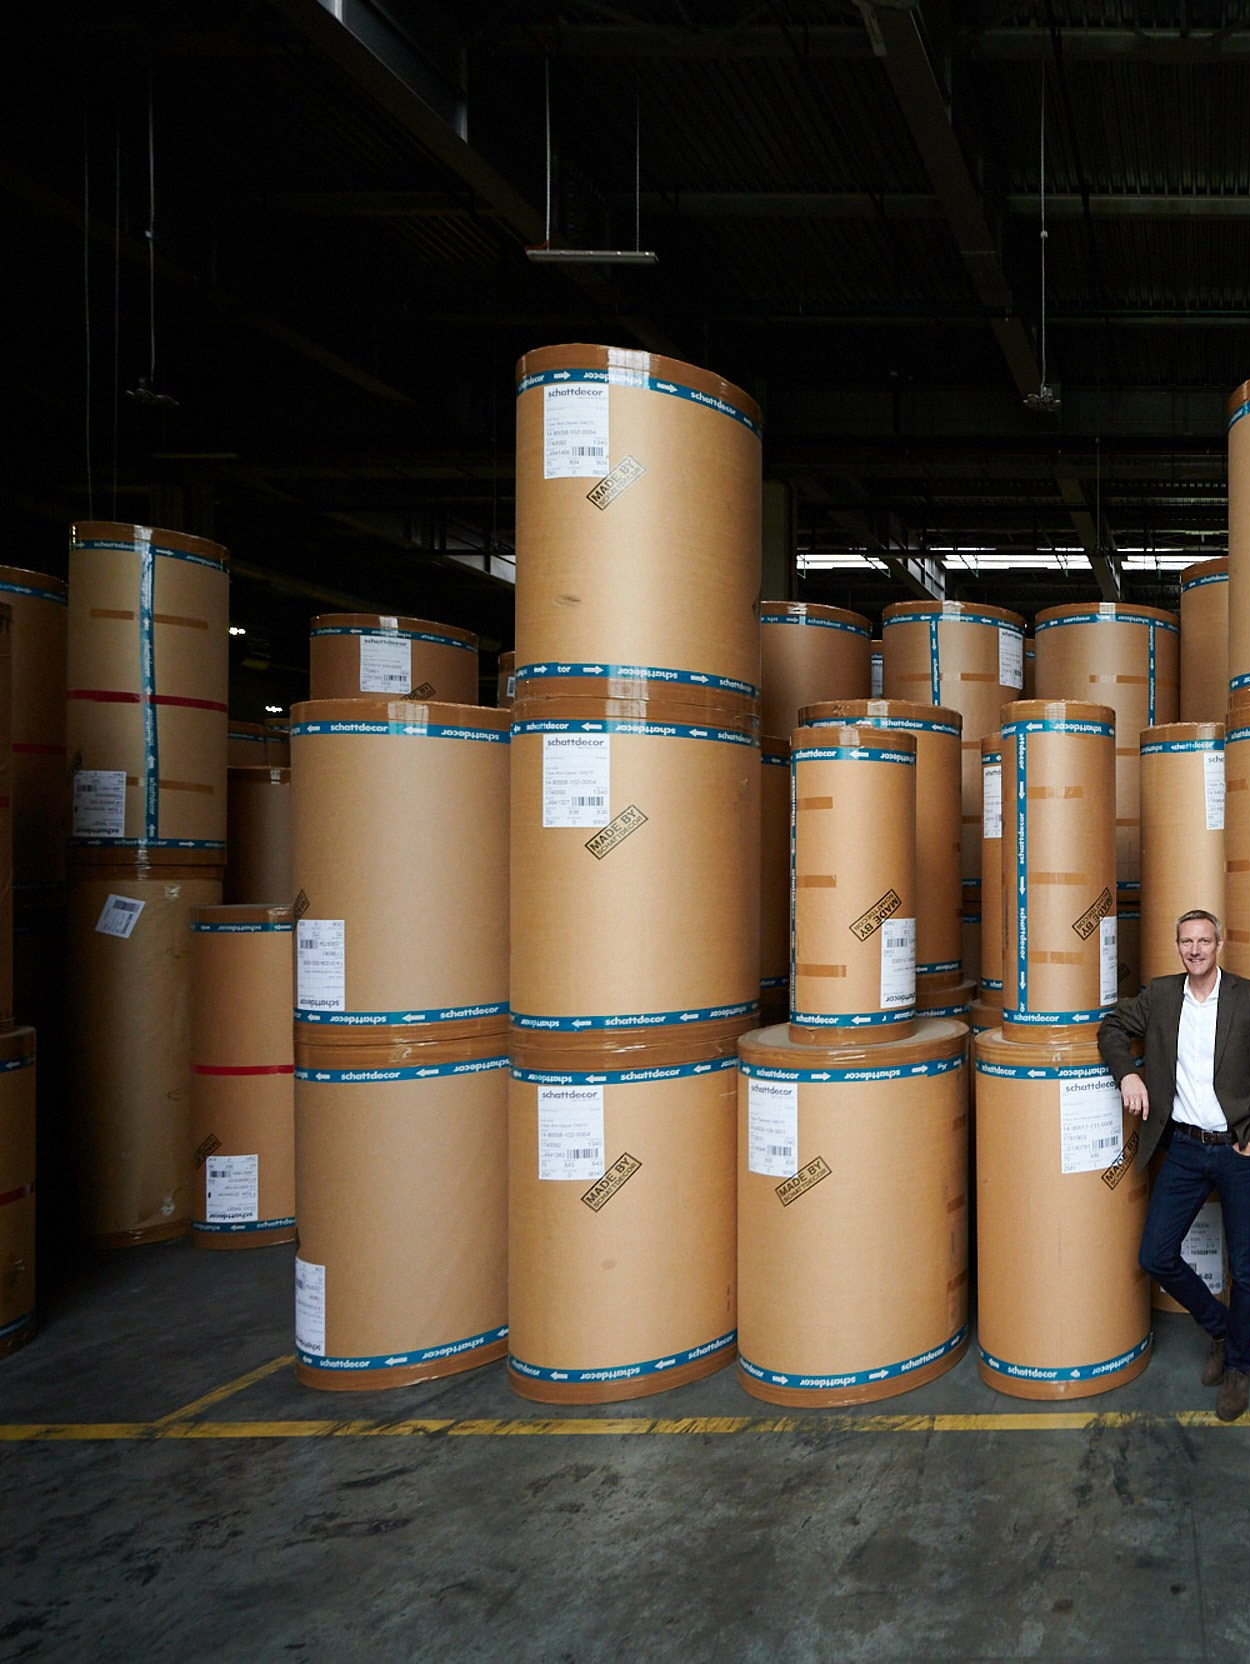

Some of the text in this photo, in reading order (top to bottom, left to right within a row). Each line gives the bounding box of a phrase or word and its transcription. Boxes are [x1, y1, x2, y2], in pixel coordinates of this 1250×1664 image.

[548, 387, 603, 398] schattdecor
[691, 391, 736, 415] schattdecor
[591, 460, 635, 502] MADE BY
[617, 668, 678, 679] schattdecor
[331, 724, 388, 732] schattdecor
[526, 722, 569, 730] schattdecor
[881, 720, 923, 728] schattdecor
[1055, 723, 1101, 733] schattdecor
[615, 725, 676, 734] schattdecor
[441, 730, 499, 740] schattdecor
[547, 738, 604, 746] schattdecor
[796, 750, 836, 758] schattdecor
[589, 809, 637, 851] MADE BY
[860, 899, 899, 937] MADE BY
[440, 1006, 499, 1019] schattdecor
[330, 1015, 387, 1024] schattdecor
[605, 1016, 666, 1025] schattdecor
[796, 1014, 839, 1024] schattdecor
[621, 1069, 680, 1080] schattdecor
[756, 1069, 799, 1079] schattdecor
[845, 1070, 900, 1079] schattdecor
[982, 1065, 1016, 1075] schattdecor
[341, 1072, 400, 1080] schattdecor
[542, 1090, 597, 1098] schattdecor
[751, 1085, 792, 1095] schattdecor
[586, 1157, 631, 1204] MADE BY
[779, 1161, 822, 1197] MADE BY
[422, 1338, 484, 1359] schattdecor
[689, 1335, 733, 1359] schattdecor
[320, 1360, 370, 1368] schattdecor
[901, 1348, 944, 1371] schattdecor
[1092, 1352, 1134, 1374] schattdecor
[580, 1368, 640, 1380] schattdecor
[1008, 1367, 1057, 1378] schattdecor
[800, 1377, 856, 1387] schattdecor
